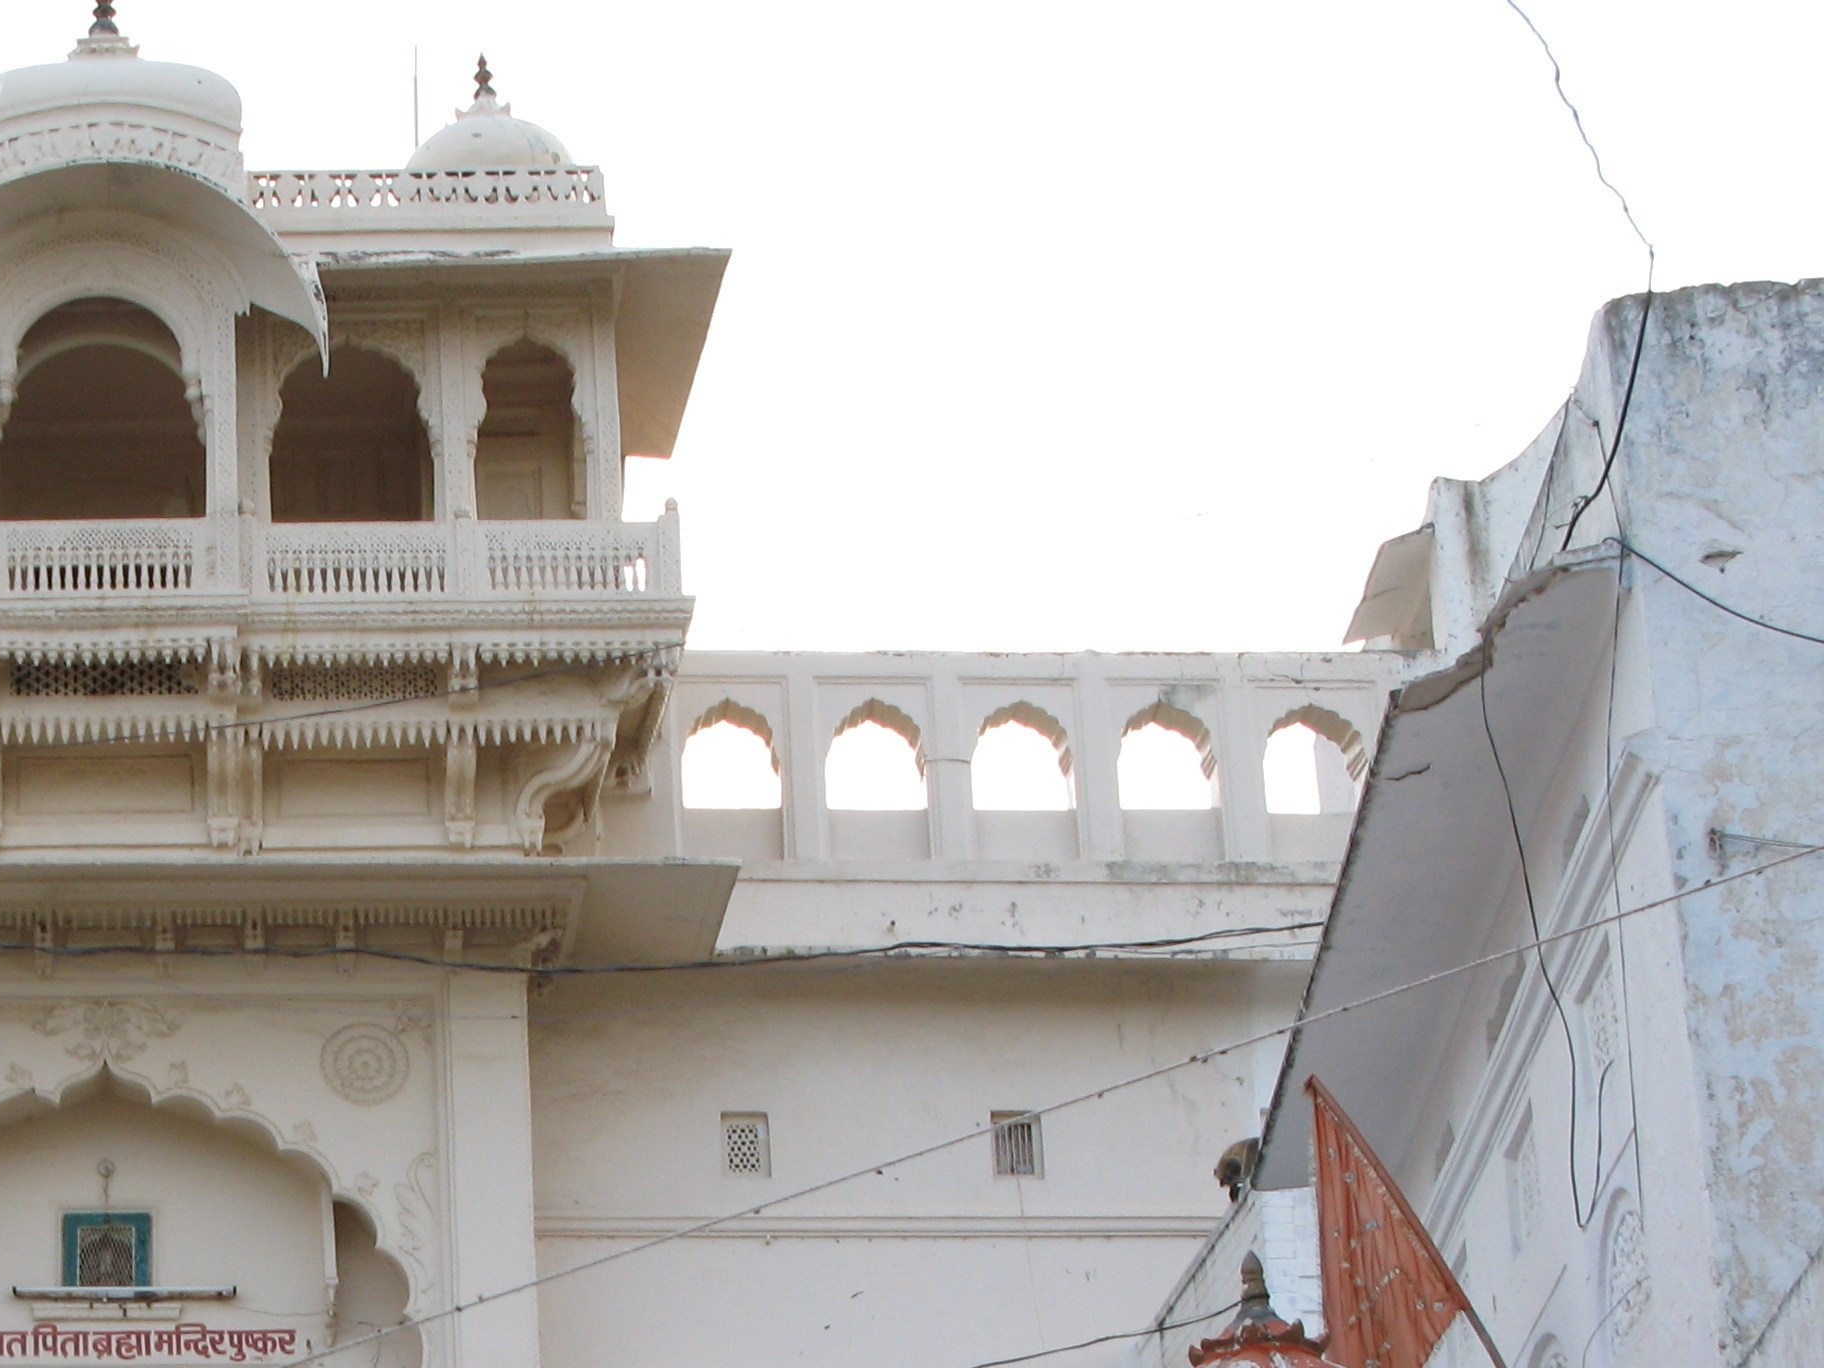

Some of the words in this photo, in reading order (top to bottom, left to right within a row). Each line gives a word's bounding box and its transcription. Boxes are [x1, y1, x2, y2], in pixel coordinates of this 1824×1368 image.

[30, 1322, 91, 1359] पिता
[92, 1330, 153, 1361] ब्रह्मा
[153, 1322, 227, 1359] मन्दिर
[227, 1329, 297, 1362] पुष्कर
